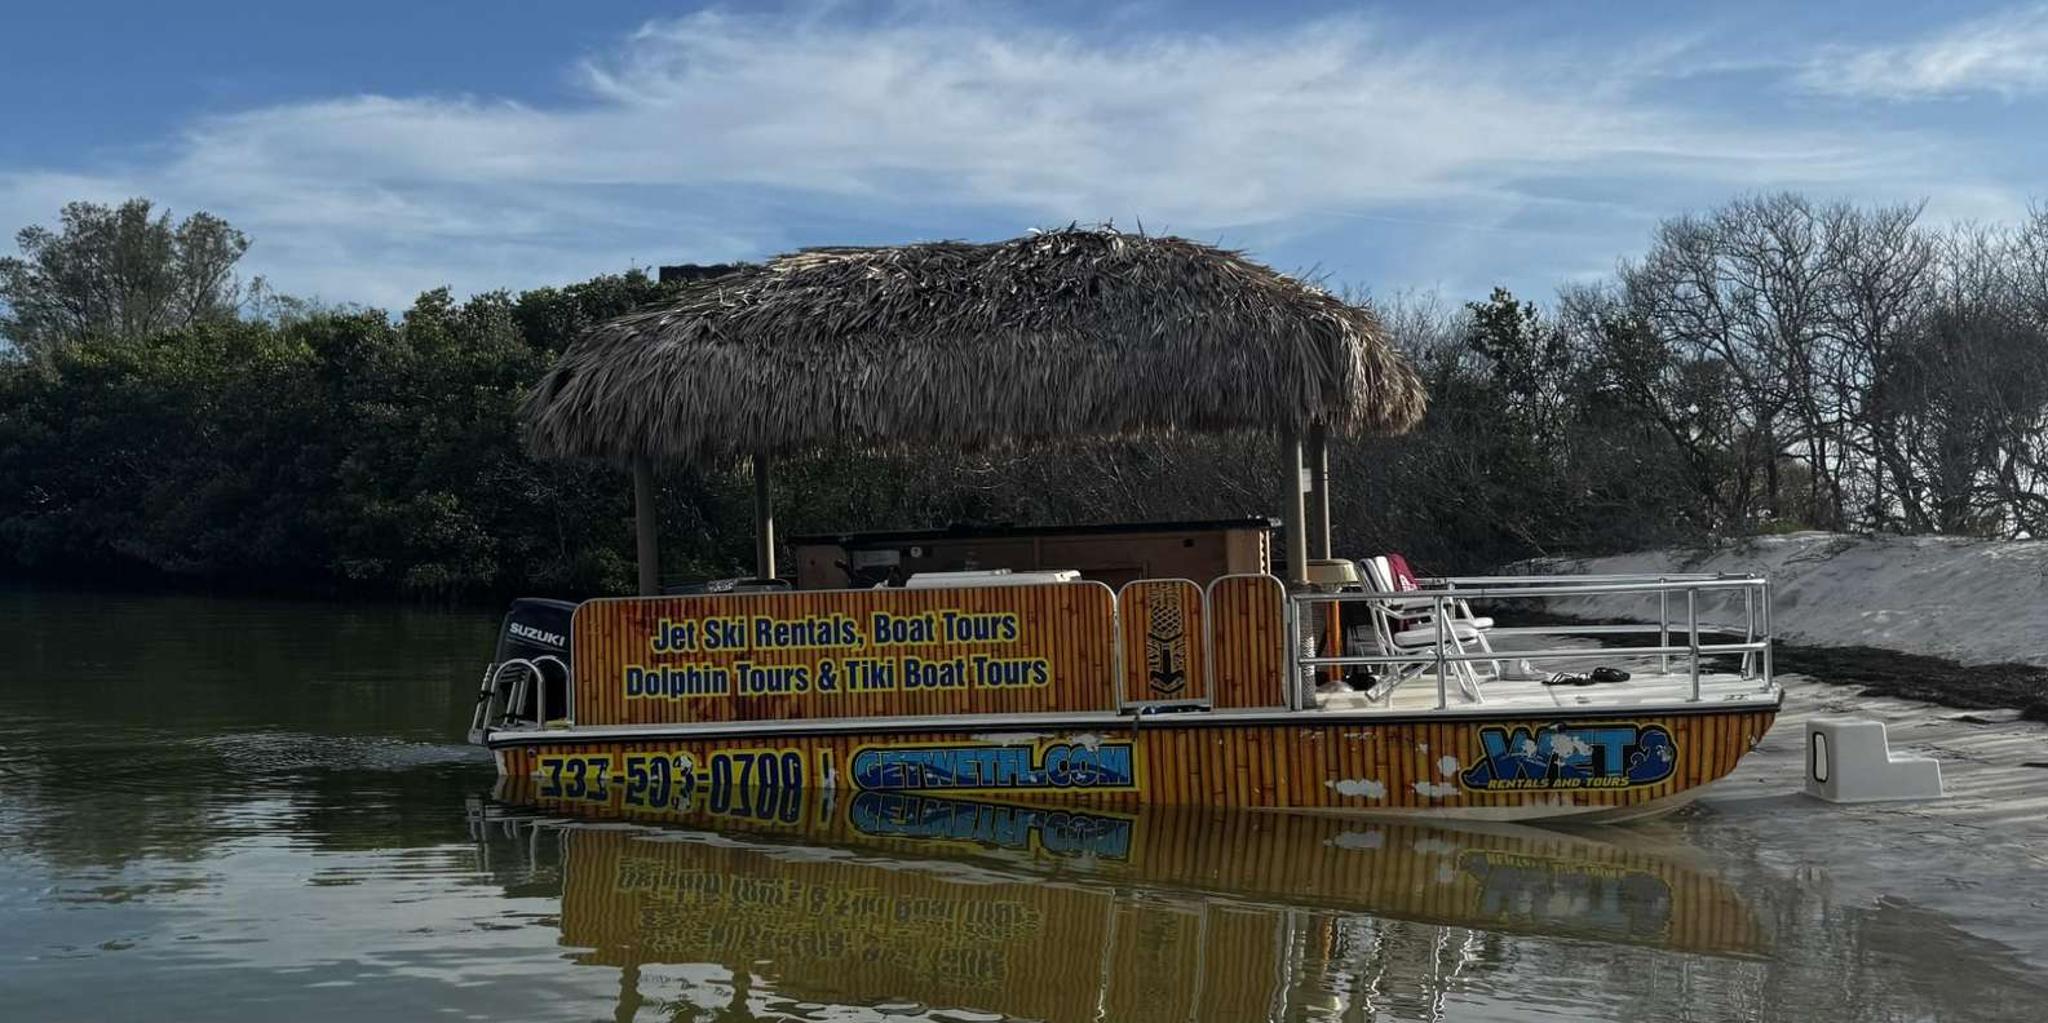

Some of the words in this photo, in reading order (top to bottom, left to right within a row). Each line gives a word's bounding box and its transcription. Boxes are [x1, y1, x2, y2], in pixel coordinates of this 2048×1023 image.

[509, 622, 565, 647] SUZUKI
[653, 619, 697, 651] Jet
[704, 618, 745, 648] Ski
[755, 615, 865, 648] Rentals,
[873, 613, 935, 643] Boat
[943, 611, 1017, 641] Tours
[625, 664, 729, 699] Dolphin
[736, 663, 810, 693] Tours
[817, 660, 838, 691] &
[845, 659, 895, 690] Tiki
[904, 658, 966, 688] Boat
[973, 655, 1049, 687] Tours
[853, 745, 1133, 789] GETWETFL.COM
[1487, 777, 1549, 790] RENTALS
[1552, 777, 1581, 788] AND
[1585, 775, 1630, 788] TOURS
